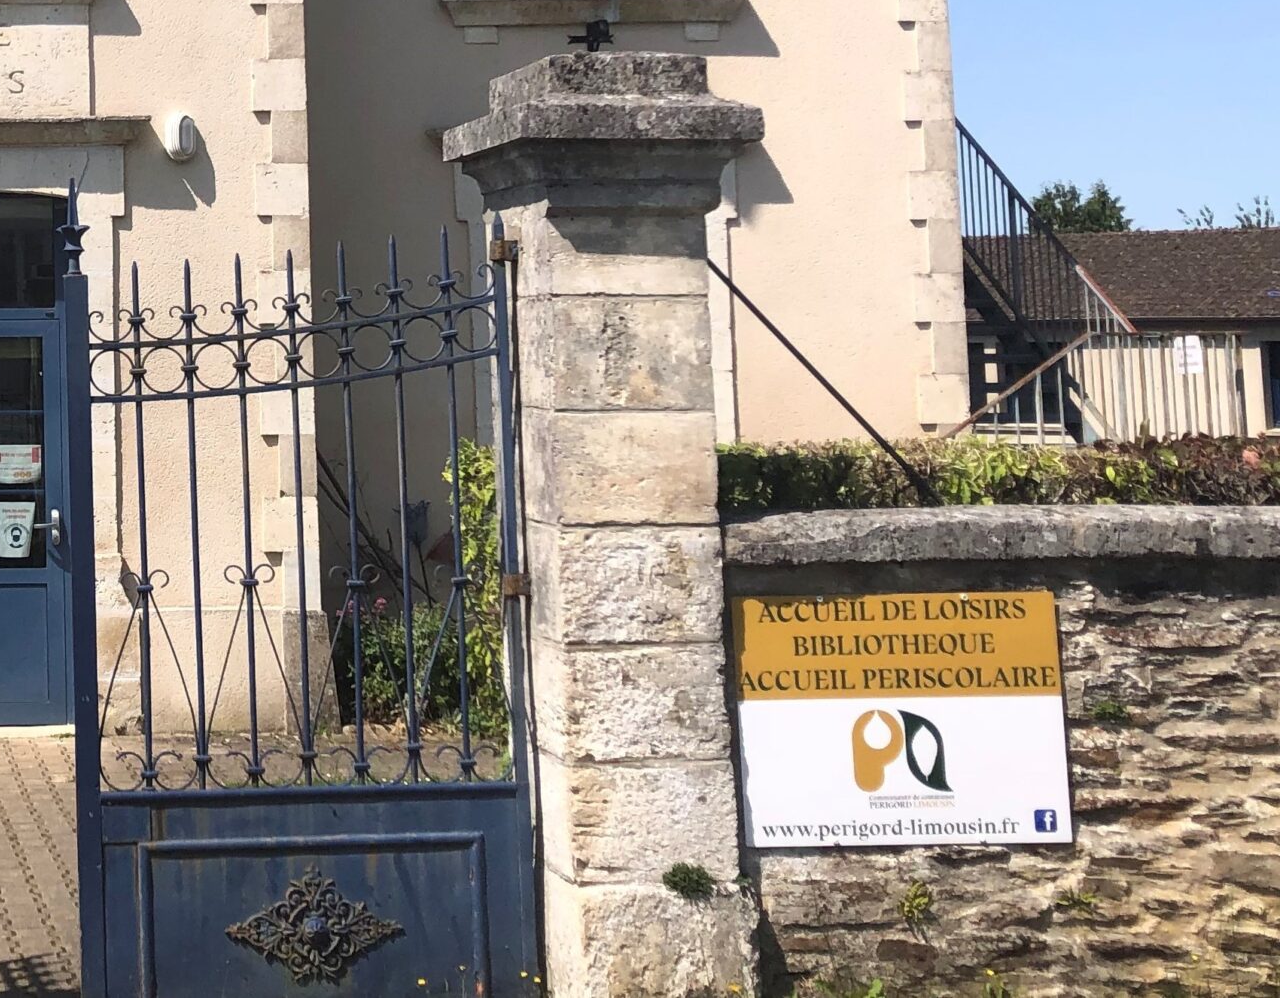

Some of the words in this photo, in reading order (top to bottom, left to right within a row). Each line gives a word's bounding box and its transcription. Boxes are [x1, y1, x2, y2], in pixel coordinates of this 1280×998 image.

[758, 598, 875, 624] ACCUEIL
[881, 599, 917, 621] DE
[924, 597, 1027, 621] LOISIRS
[792, 632, 996, 657] BIBLIOTHEQUE
[739, 668, 856, 692] ACCUEIL
[862, 665, 1057, 690] PERISCOLAIRE
[869, 801, 912, 809] PERIGORD
[761, 816, 1020, 842] www.perigord-limousin.fr
